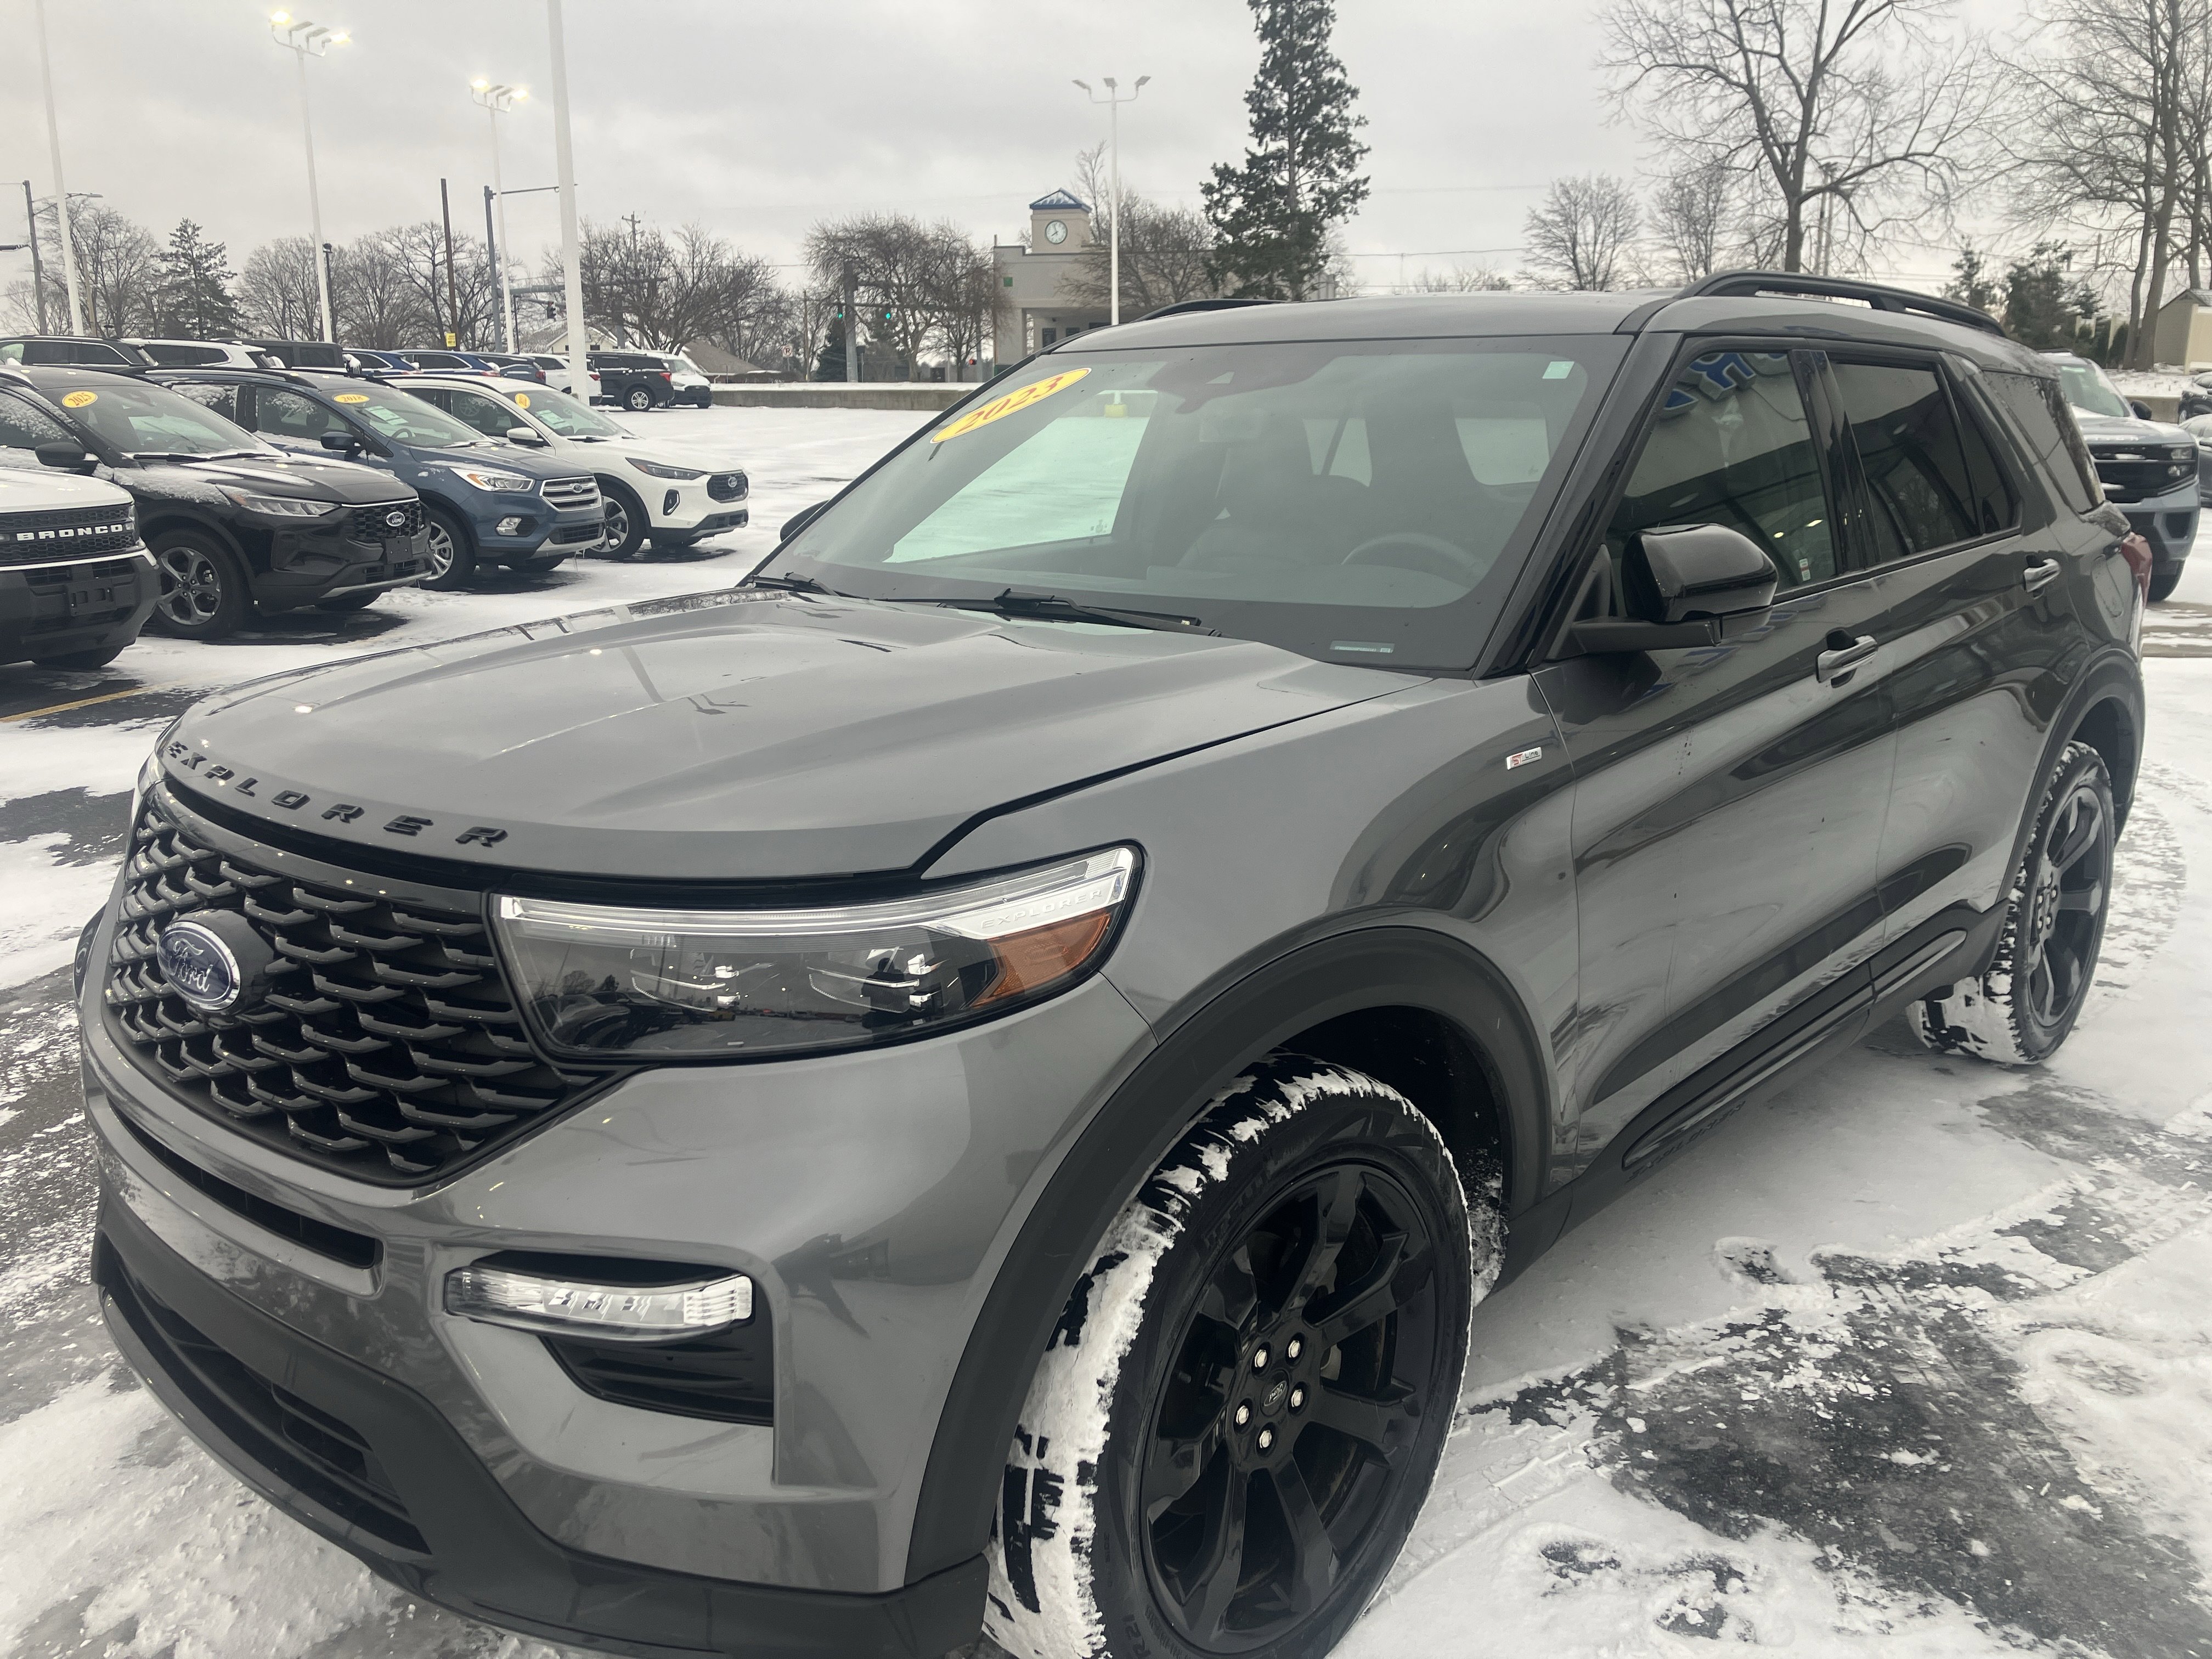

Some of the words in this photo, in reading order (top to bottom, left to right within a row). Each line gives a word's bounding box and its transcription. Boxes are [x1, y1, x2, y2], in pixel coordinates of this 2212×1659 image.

[955, 376, 1064, 434] 2023
[16, 524, 123, 541] BRONCO
[1511, 753, 1523, 765] ST
[167, 741, 510, 847] EXPLORER
[981, 889, 1102, 928] EXPLORER
[168, 938, 213, 992] Ford
